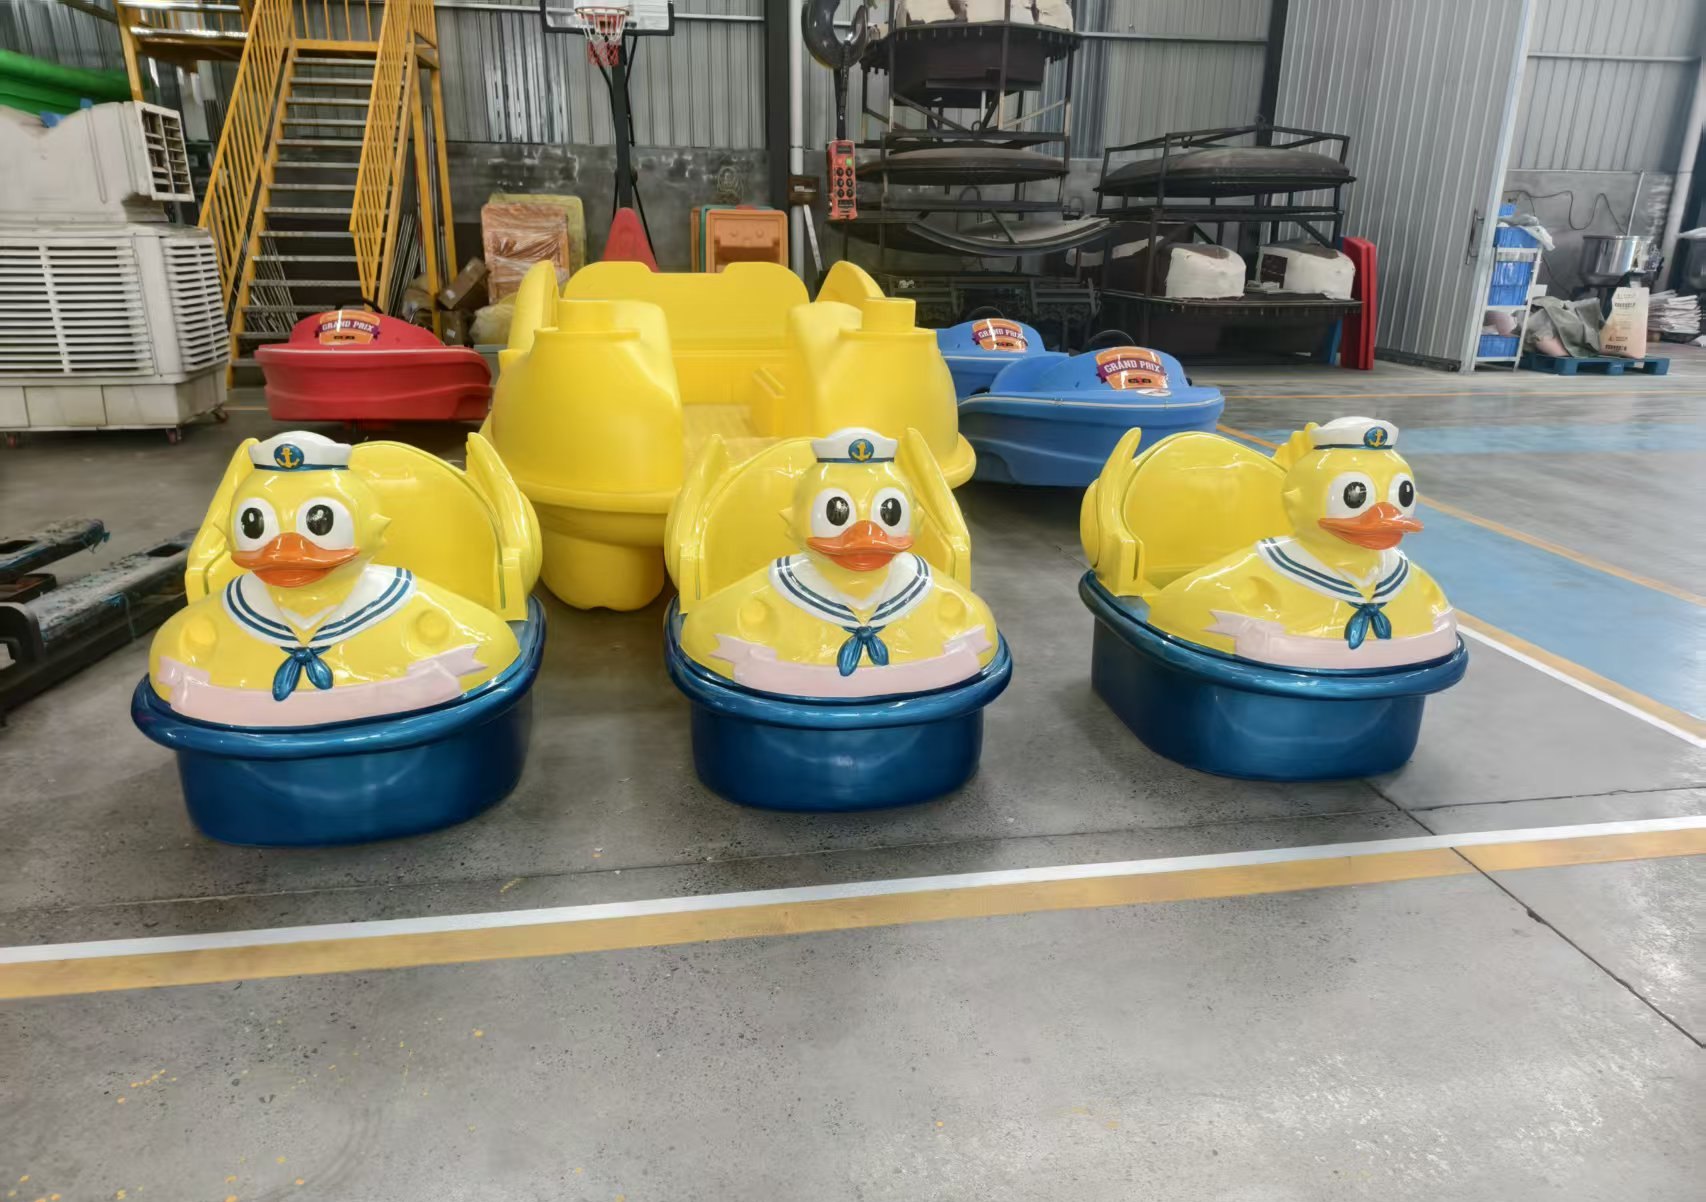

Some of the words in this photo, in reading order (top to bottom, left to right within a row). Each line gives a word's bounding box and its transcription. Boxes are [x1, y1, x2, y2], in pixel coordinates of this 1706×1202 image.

[322, 320, 350, 331] GRAND
[352, 320, 374, 332] PRIX
[1005, 328, 1024, 339] PRIX
[1103, 360, 1138, 373] GRAND
[1140, 360, 1160, 372] PRIX
